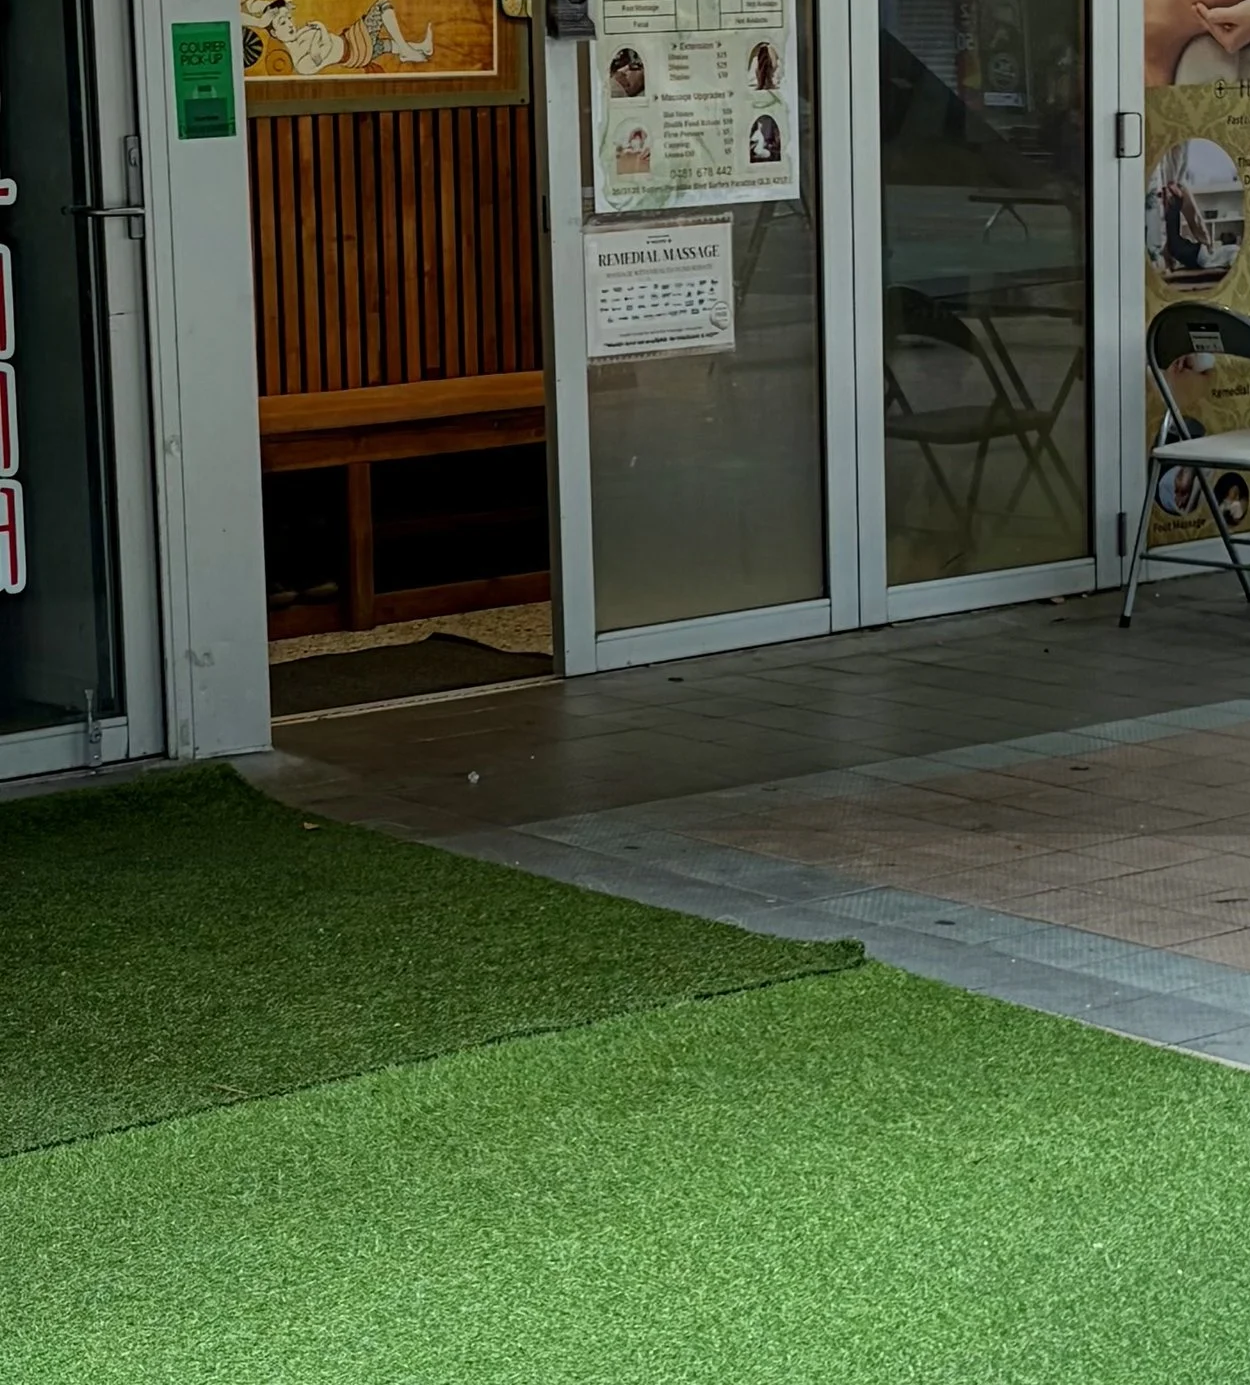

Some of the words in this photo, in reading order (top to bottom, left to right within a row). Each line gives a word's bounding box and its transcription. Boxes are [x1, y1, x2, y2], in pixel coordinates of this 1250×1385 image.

[179, 40, 226, 54] COURIER
[180, 53, 223, 66] PICK-UP
[716, 165, 732, 176] 442
[598, 250, 660, 267] REMEDIAL
[663, 244, 720, 261] MASSAGE
